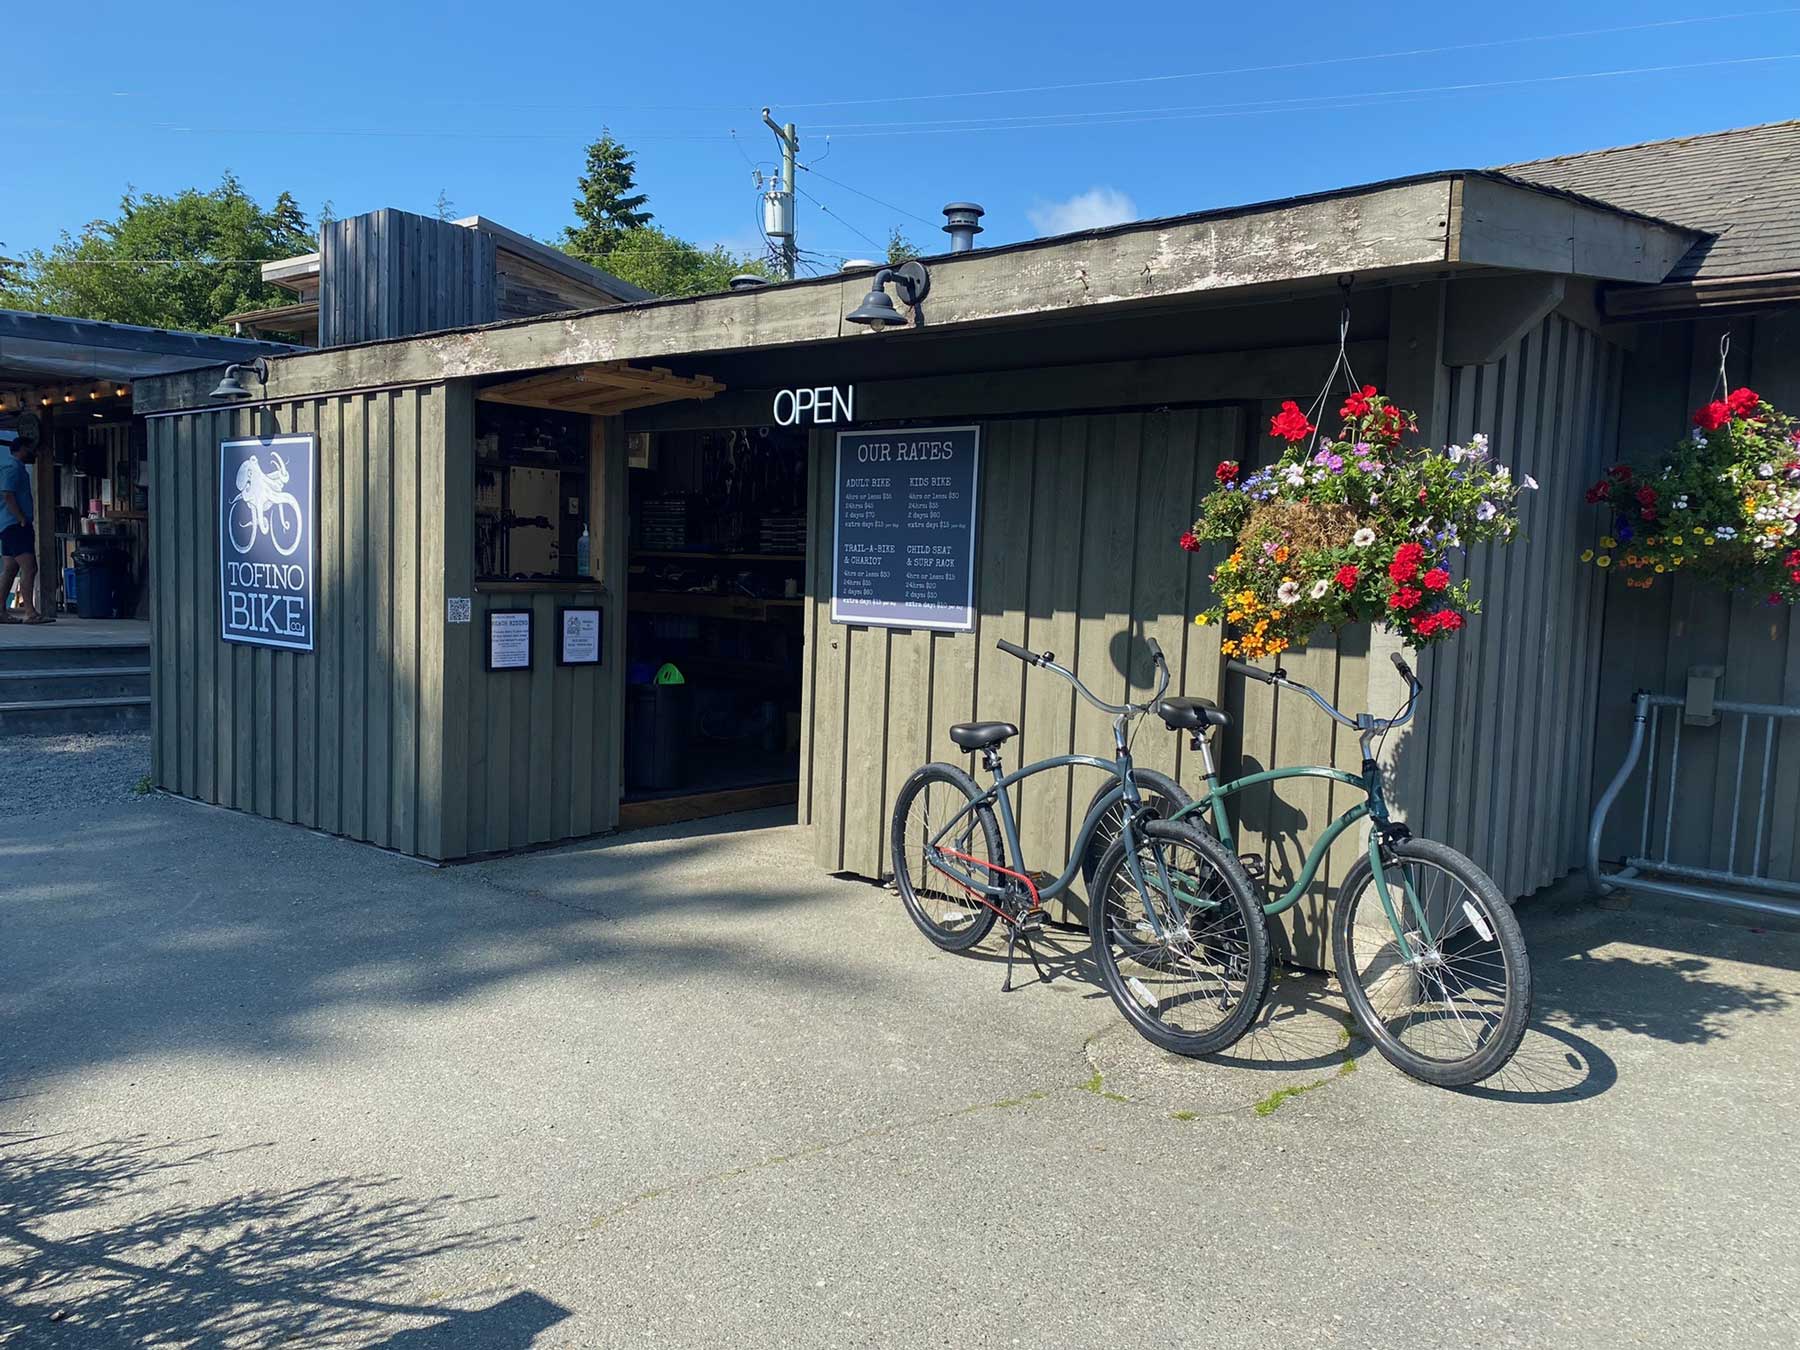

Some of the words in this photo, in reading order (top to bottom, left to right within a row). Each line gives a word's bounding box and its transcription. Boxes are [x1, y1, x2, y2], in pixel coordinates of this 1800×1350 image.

[773, 384, 853, 426] OPEN
[857, 443, 892, 462] OUR
[896, 441, 953, 461] RATES
[846, 478, 870, 487] ADULT
[871, 478, 891, 487] BIKE
[909, 477, 929, 487] KIDS
[931, 477, 951, 486] BIKE
[844, 544, 895, 554] TRAIL-A-BIKE
[907, 545, 931, 555] CHILD
[932, 545, 952, 555] SEAT
[851, 556, 882, 566] CHARIOT
[906, 558, 913, 566] &
[914, 558, 933, 567] SURF
[935, 558, 955, 568] RACK
[228, 562, 304, 590] TOFINO
[228, 591, 305, 637] BIKE
